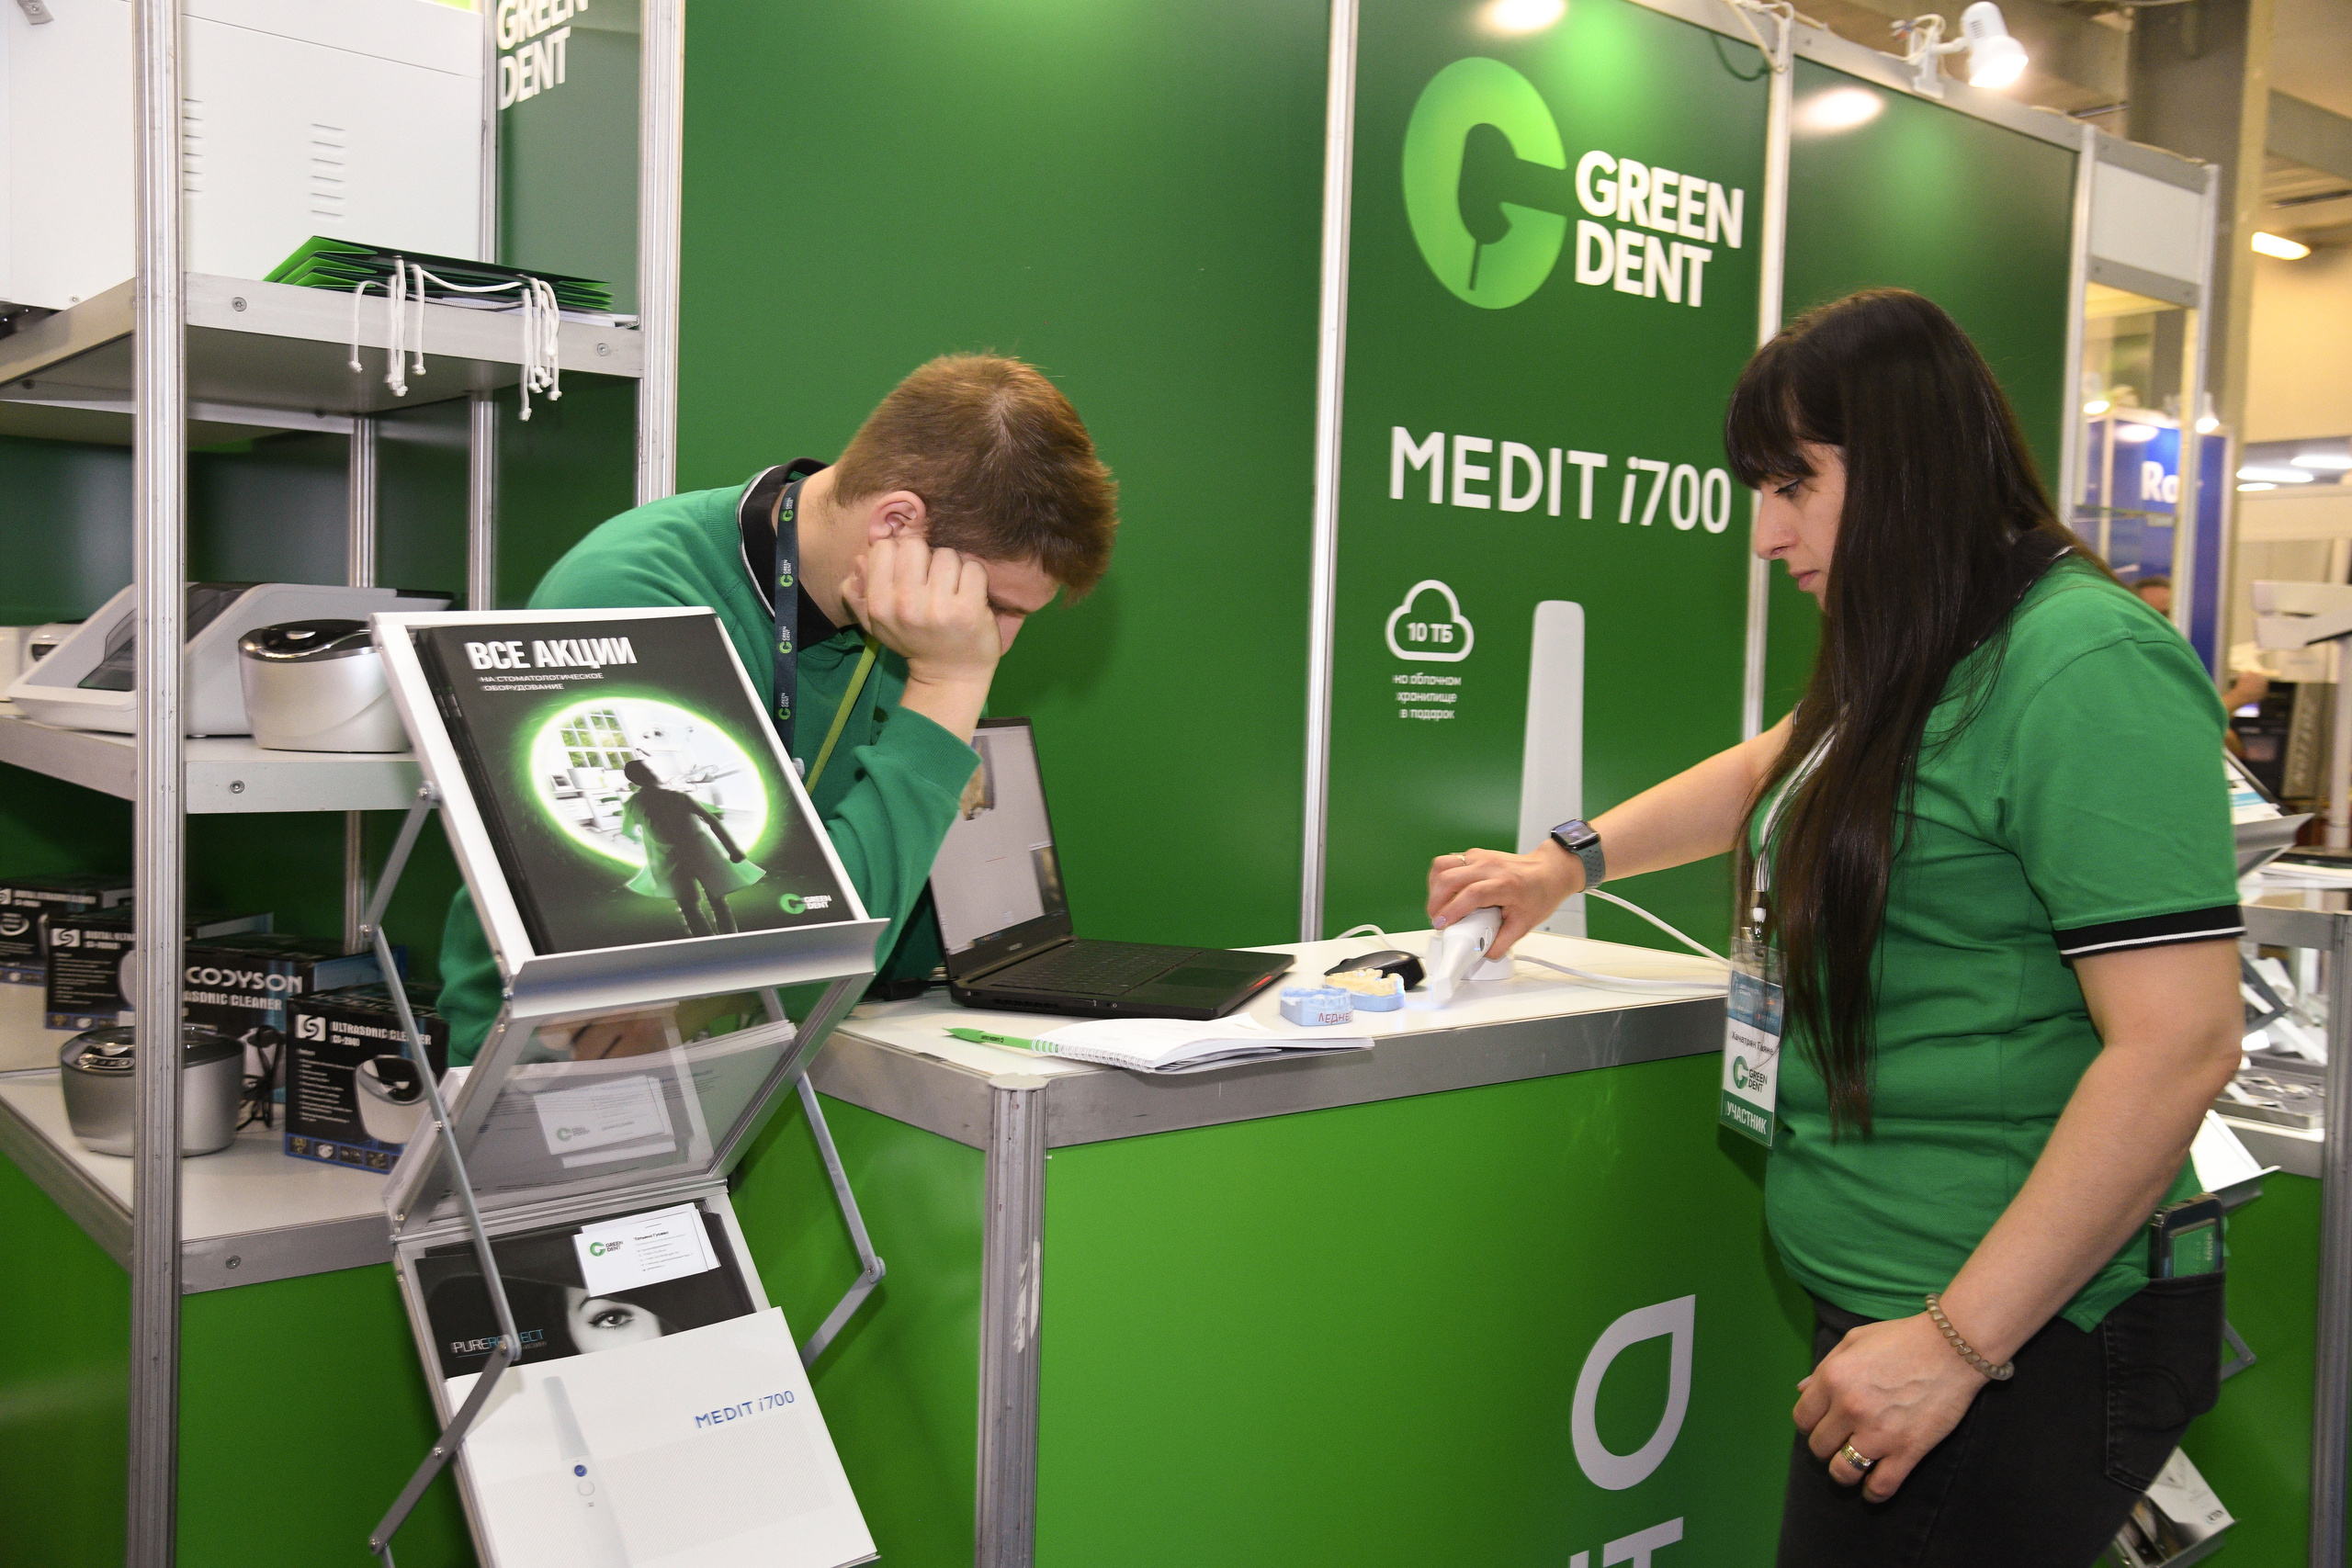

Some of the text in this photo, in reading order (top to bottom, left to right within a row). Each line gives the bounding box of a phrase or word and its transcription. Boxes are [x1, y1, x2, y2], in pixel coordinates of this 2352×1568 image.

[497, 26, 571, 110] DENT
[1575, 150, 1744, 248] GREEN
[1575, 220, 1713, 308] DENT
[1389, 426, 1732, 534] MEDIT i700
[1407, 622, 1453, 643] 10 ТБ
[464, 637, 638, 670] ВСЕ АКЦИИ
[482, 683, 564, 692] ОБОРУДОВАНИЕ
[497, 672, 604, 682] СТОМАТОЛОГИЧЕСКОЕ
[806, 901, 829, 909] DENT
[186, 966, 302, 994] CODYSON
[184, 990, 282, 1010] ASONIC CLEANER
[330, 1021, 432, 1045] ULTRASONIC CLEER
[1747, 1078, 1763, 1093] DENT
[1748, 1068, 1768, 1085] GREEN
[1727, 1100, 1767, 1135] УЧАСТНИК
[452, 1328, 544, 1354] PUREREECT
[695, 1390, 795, 1428] MEDIT i700
